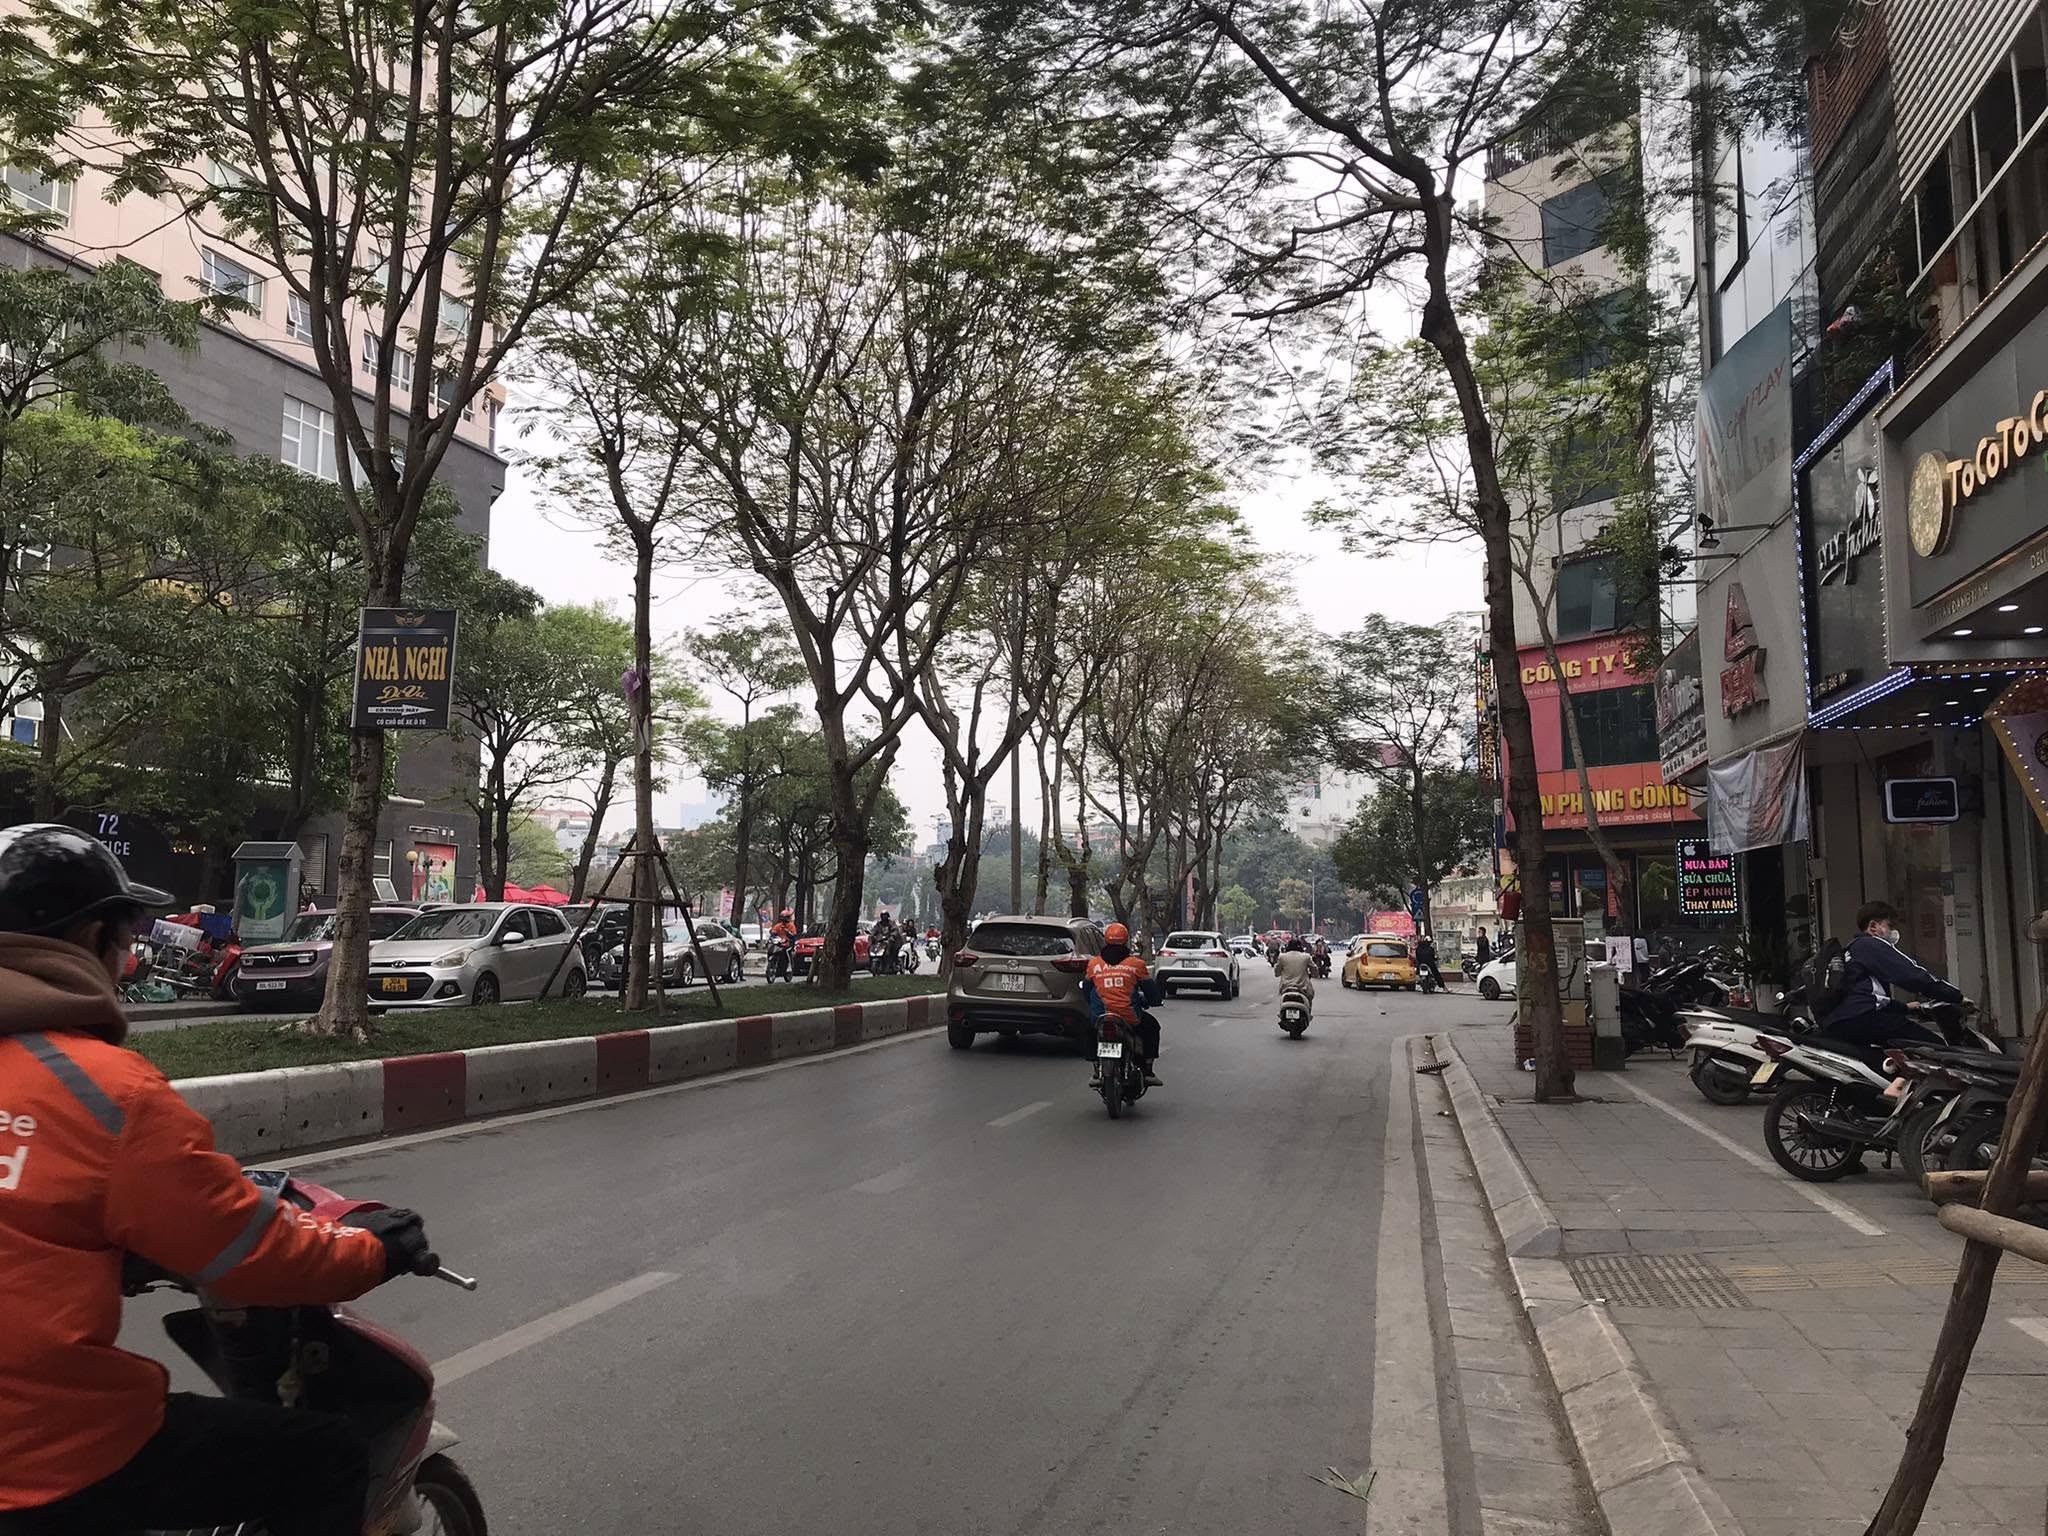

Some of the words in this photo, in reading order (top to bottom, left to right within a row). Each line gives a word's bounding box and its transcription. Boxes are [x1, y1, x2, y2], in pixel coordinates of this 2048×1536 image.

[363, 636, 399, 681] NHÀ
[404, 635, 448, 681] NGHỈ
[1588, 654, 1616, 676] TY
[1558, 787, 1625, 815] PHNG
[1629, 781, 1687, 809] CÔNG
[98, 813, 120, 835] 72
[1685, 860, 1707, 870] MUA
[1708, 857, 1729, 869] BÁN
[1683, 872, 1703, 884] SỬA
[1705, 871, 1732, 883] CHỮA
[1703, 885, 1732, 897] KÍNH
[1685, 900, 1709, 910] THAY
[1712, 899, 1734, 909] MÀN
